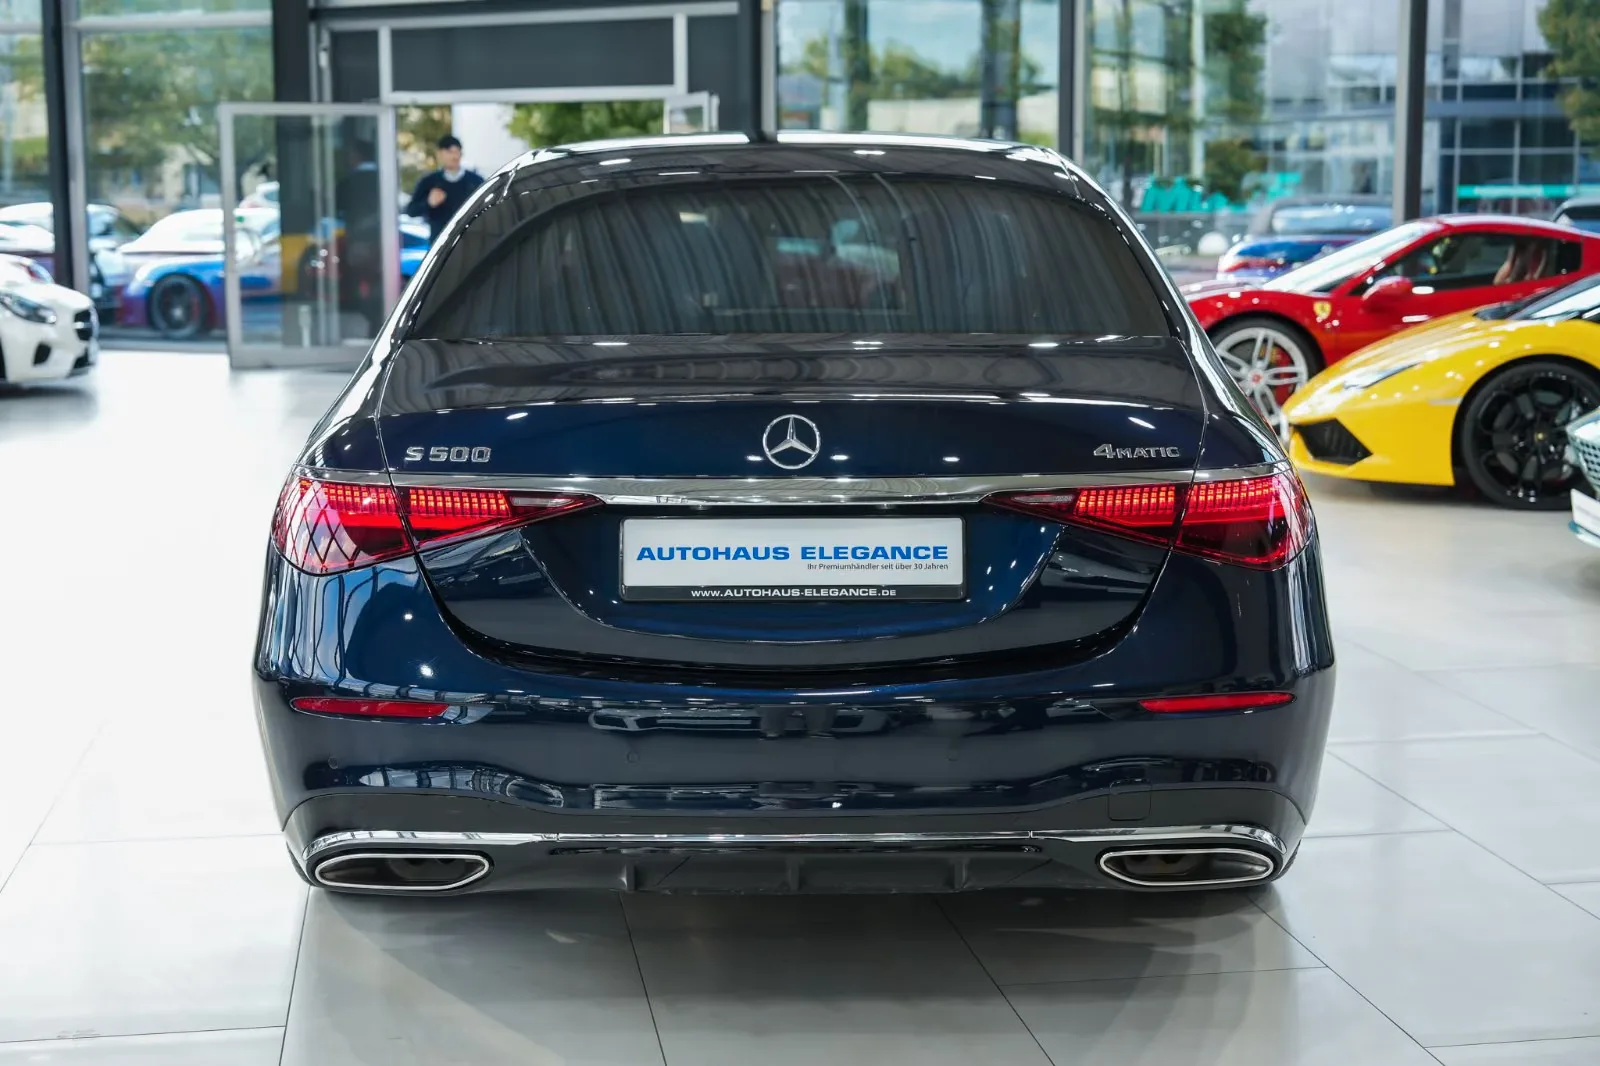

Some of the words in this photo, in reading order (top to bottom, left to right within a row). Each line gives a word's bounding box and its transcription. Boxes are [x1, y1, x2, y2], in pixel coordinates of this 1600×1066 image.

[404, 446, 425, 461] S
[429, 446, 492, 462] 500
[1093, 443, 1181, 459] 4MATIC
[636, 546, 790, 561] AUTOHAUS
[801, 546, 948, 560] ELEGANCE
